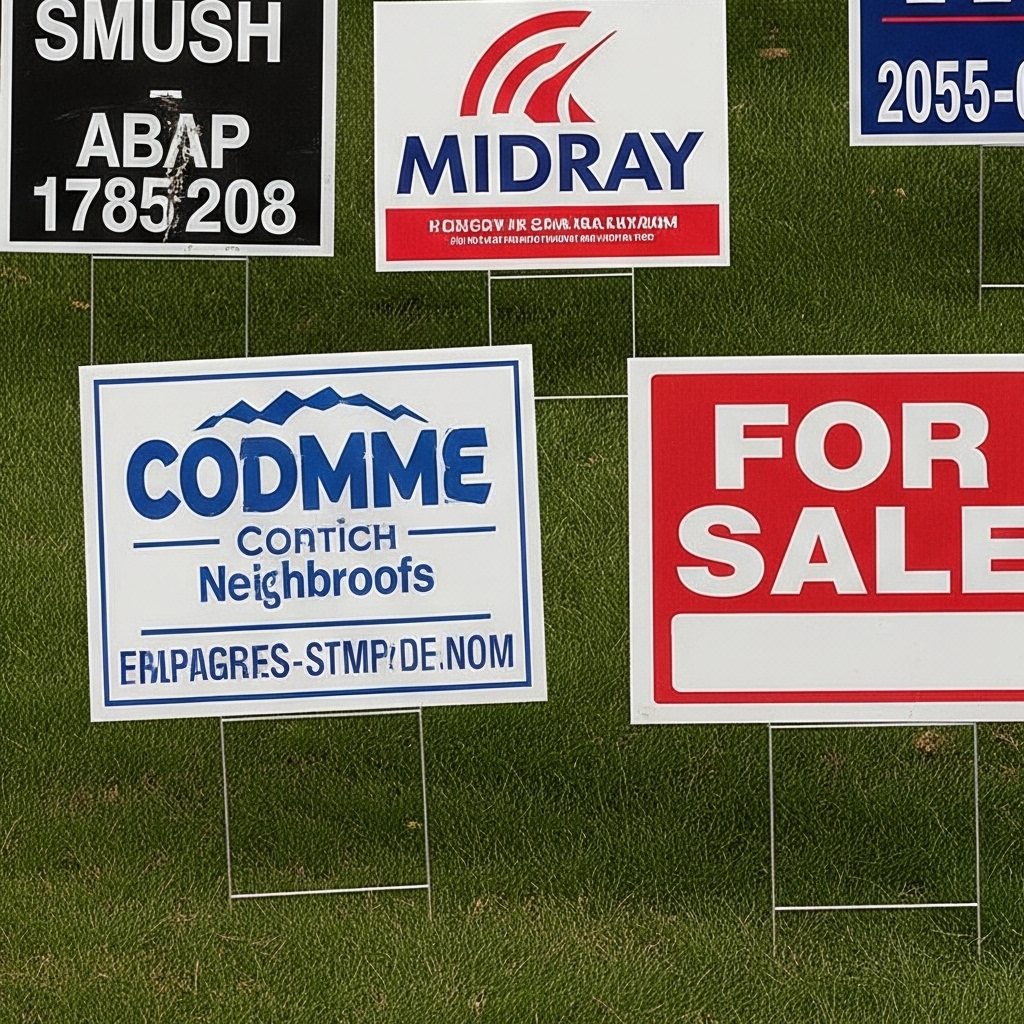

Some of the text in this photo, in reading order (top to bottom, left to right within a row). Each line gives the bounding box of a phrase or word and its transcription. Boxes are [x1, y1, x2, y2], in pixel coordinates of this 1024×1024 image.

[396, 131, 705, 196] MIDRAY
[126, 427, 492, 520] CODMME
[714, 400, 990, 491] FOR
